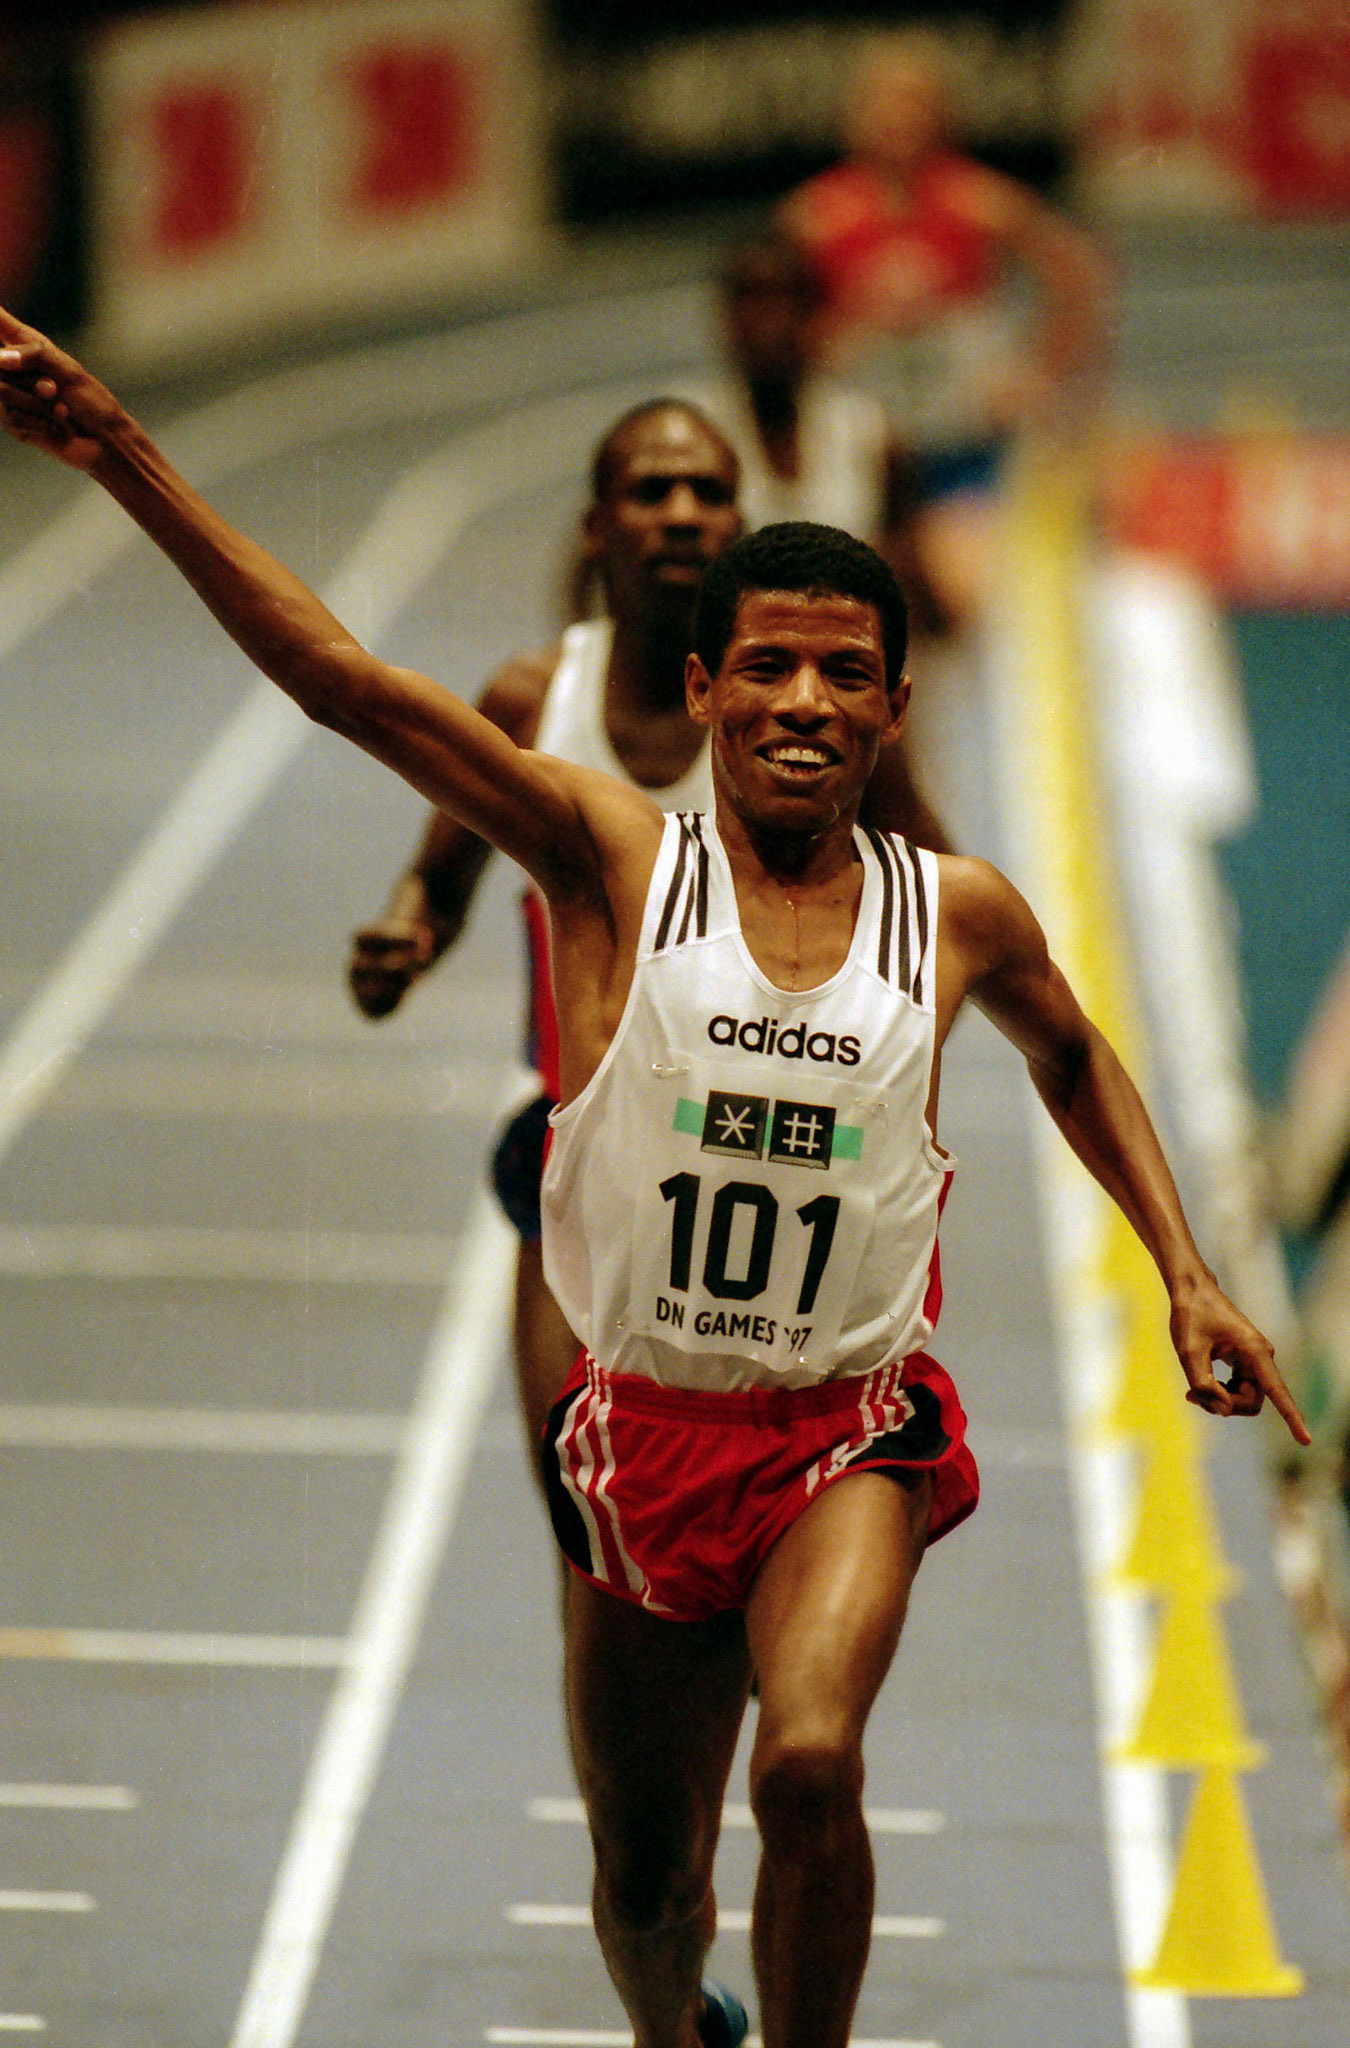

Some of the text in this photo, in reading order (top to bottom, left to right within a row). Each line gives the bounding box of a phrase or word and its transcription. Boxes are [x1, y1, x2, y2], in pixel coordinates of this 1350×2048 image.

[708, 1015, 861, 1066] adidas
[659, 1171, 841, 1315] 101
[656, 1296, 685, 1329] DN
[694, 1311, 777, 1346] GAMES
